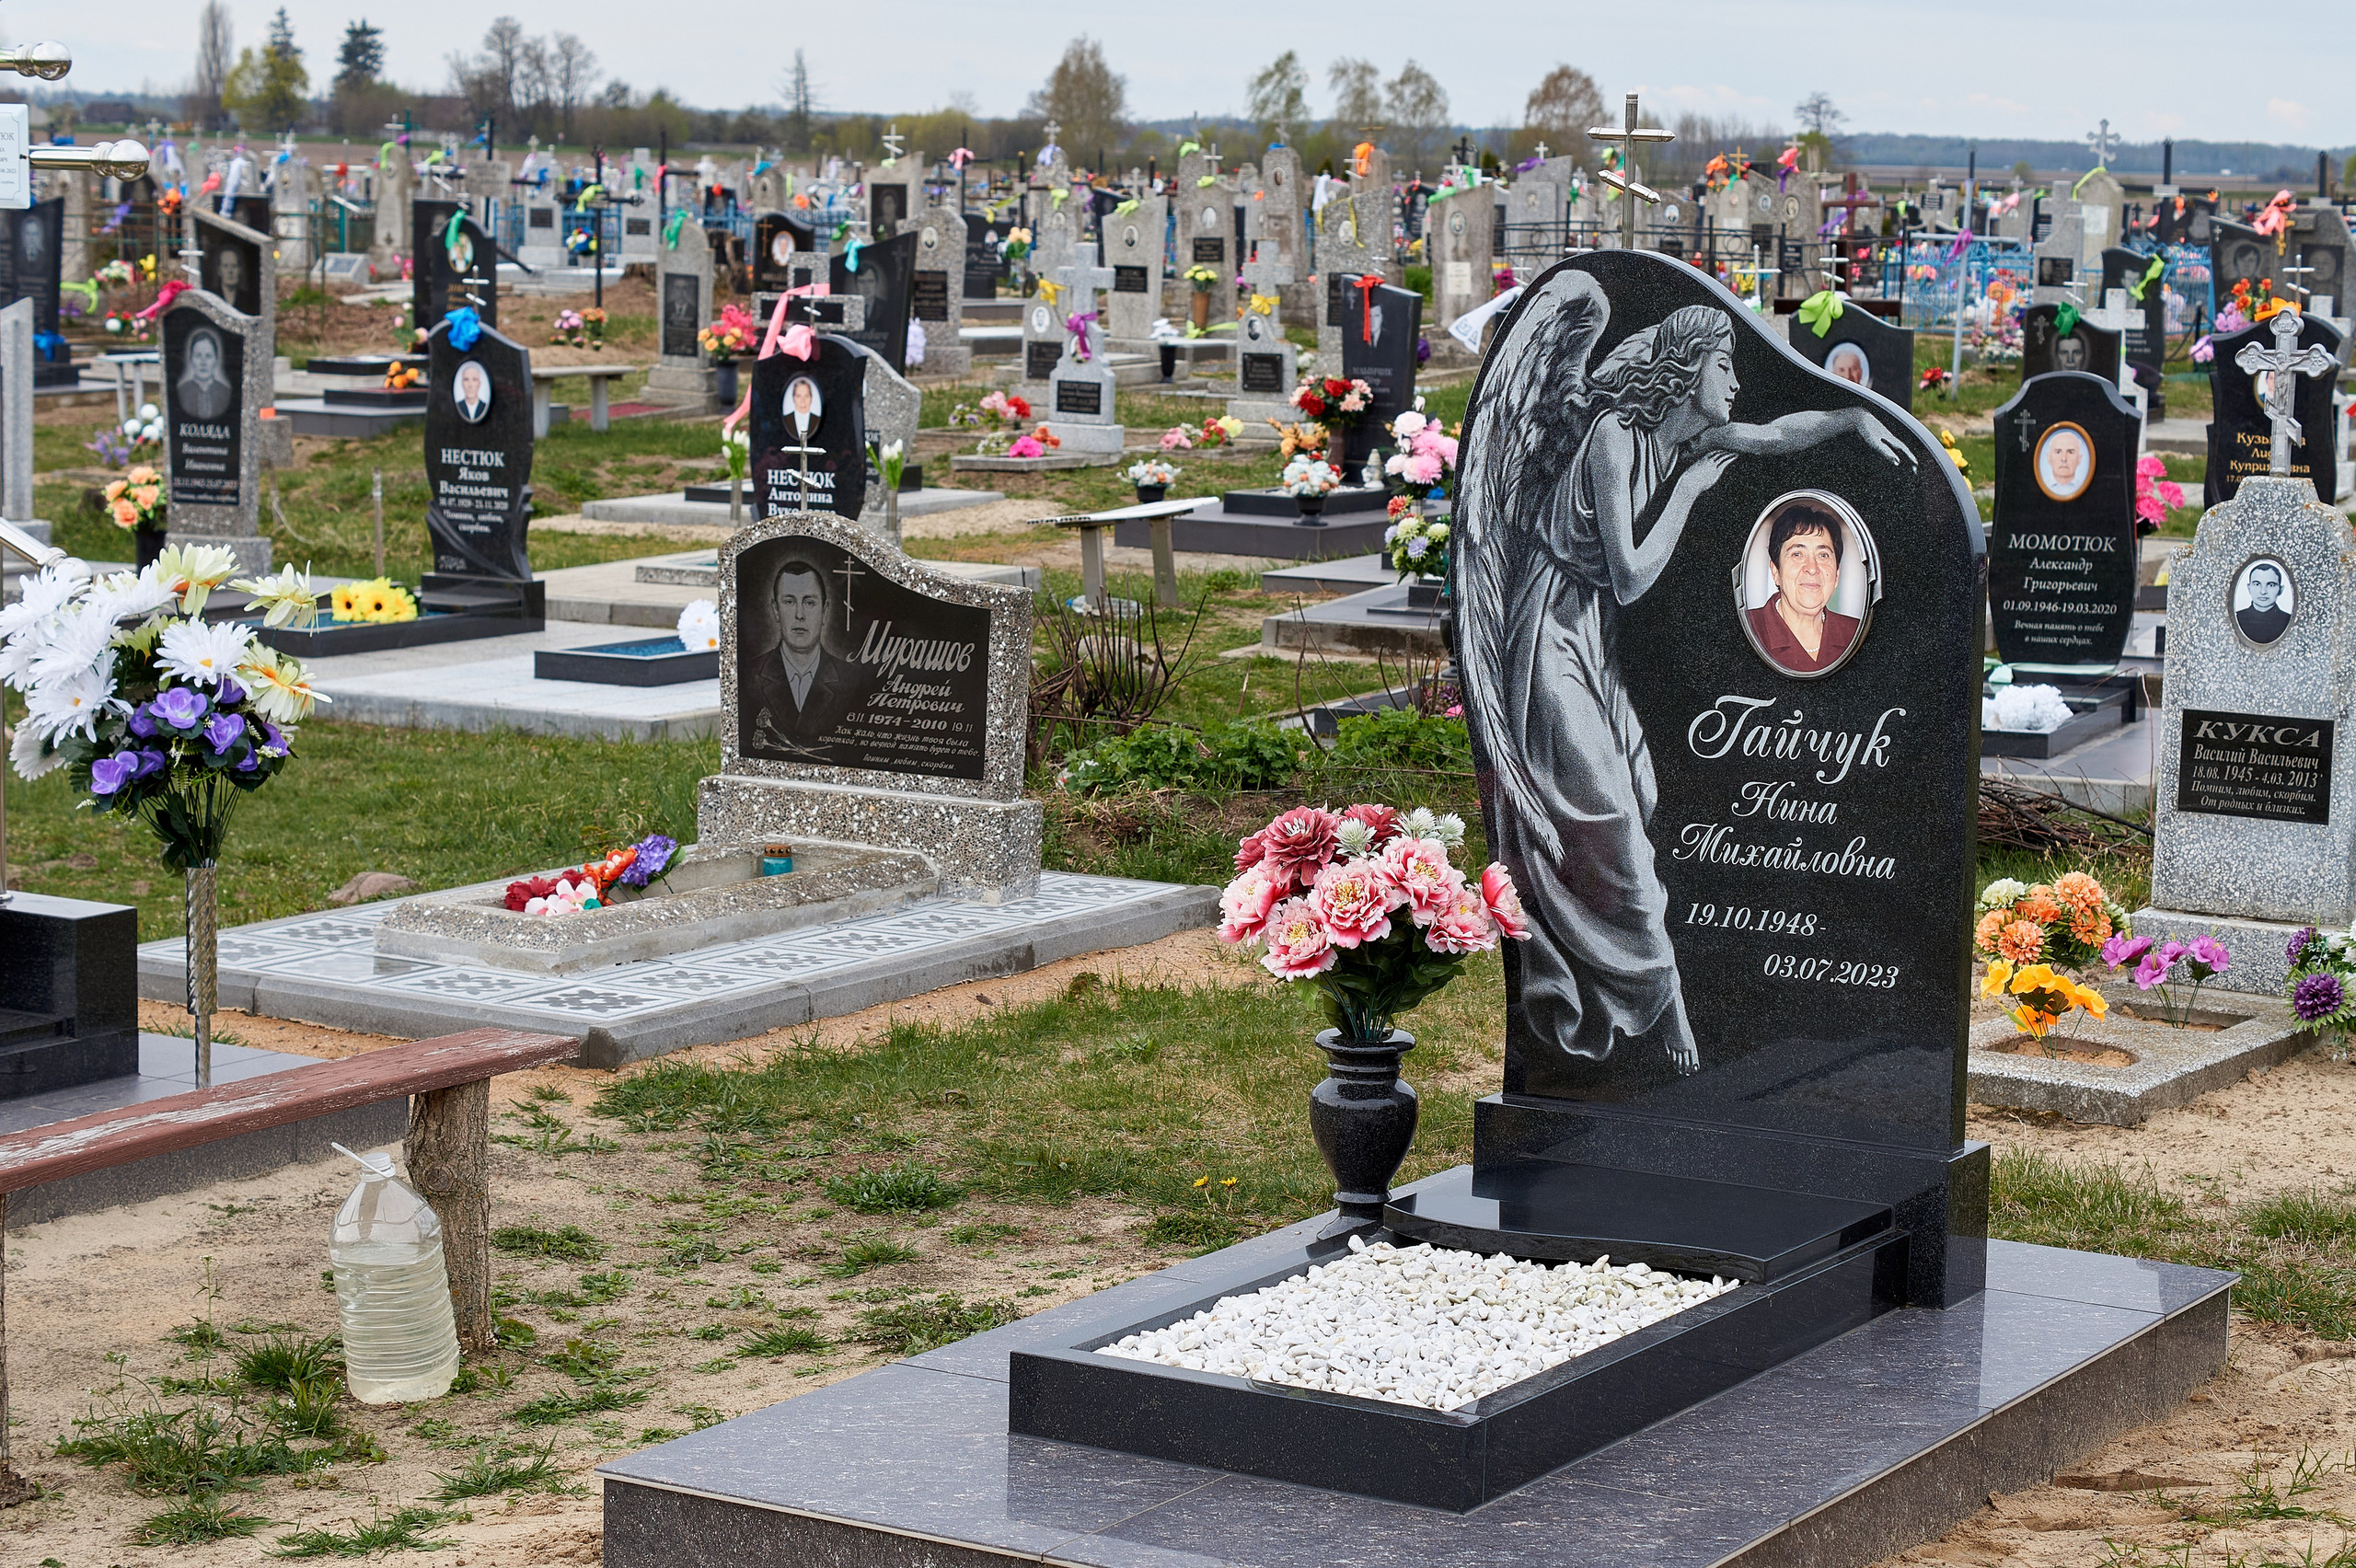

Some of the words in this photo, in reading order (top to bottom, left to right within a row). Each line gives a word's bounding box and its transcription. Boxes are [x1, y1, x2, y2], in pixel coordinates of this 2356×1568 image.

[179, 423, 231, 439] КОЛЯДА
[441, 448, 505, 467] НЕСТЮК
[458, 467, 490, 481] Яков
[767, 469, 836, 489] НЕСЮК
[439, 480, 509, 498] Васильевич
[768, 487, 833, 503] Антоина
[2008, 533, 2117, 552] МОМОТЮК
[2029, 557, 2093, 575] Александр
[2023, 576, 2097, 594] Григорьевич
[2004, 600, 2117, 615] 01.09.1946-19.03.2020
[2014, 619, 2043, 630] Вечная
[2044, 622, 2076, 631] память
[2084, 622, 2105, 632] тебе
[846, 619, 976, 678] Мурашов
[2031, 635, 2058, 643] наших
[2059, 635, 2093, 647] сердцах.
[882, 674, 953, 699] Андрей
[867, 694, 965, 715] Петрович
[835, 725, 852, 734] Как
[876, 732, 892, 740] что
[894, 732, 920, 742] жизнь
[921, 736, 944, 744] твоя
[945, 737, 969, 747] была
[1688, 695, 1906, 784] Гайчук
[2193, 720, 2320, 747] КУКСА
[817, 735, 857, 747] короткой,
[898, 743, 928, 752] память
[929, 744, 951, 755] будет
[957, 748, 980, 756] тебе.
[2194, 743, 2246, 764] Василий
[2247, 747, 2320, 770] Васильевич
[2192, 765, 2221, 780] 18.08.
[2223, 765, 2254, 782] 1945
[2261, 771, 2284, 786] 4.03.
[2287, 770, 2318, 789] 2013
[2191, 780, 2235, 795] Помним,
[2235, 786, 2271, 800] любим,
[2273, 790, 2316, 802] скорбим.
[1731, 781, 1839, 824] Нина
[2200, 795, 2217, 807] От
[2218, 797, 2255, 811] родных
[2257, 802, 2262, 811] и
[2264, 801, 2305, 815] близких.
[1672, 823, 1896, 880] Михайловна
[1763, 953, 1900, 988] 03.07.2023
